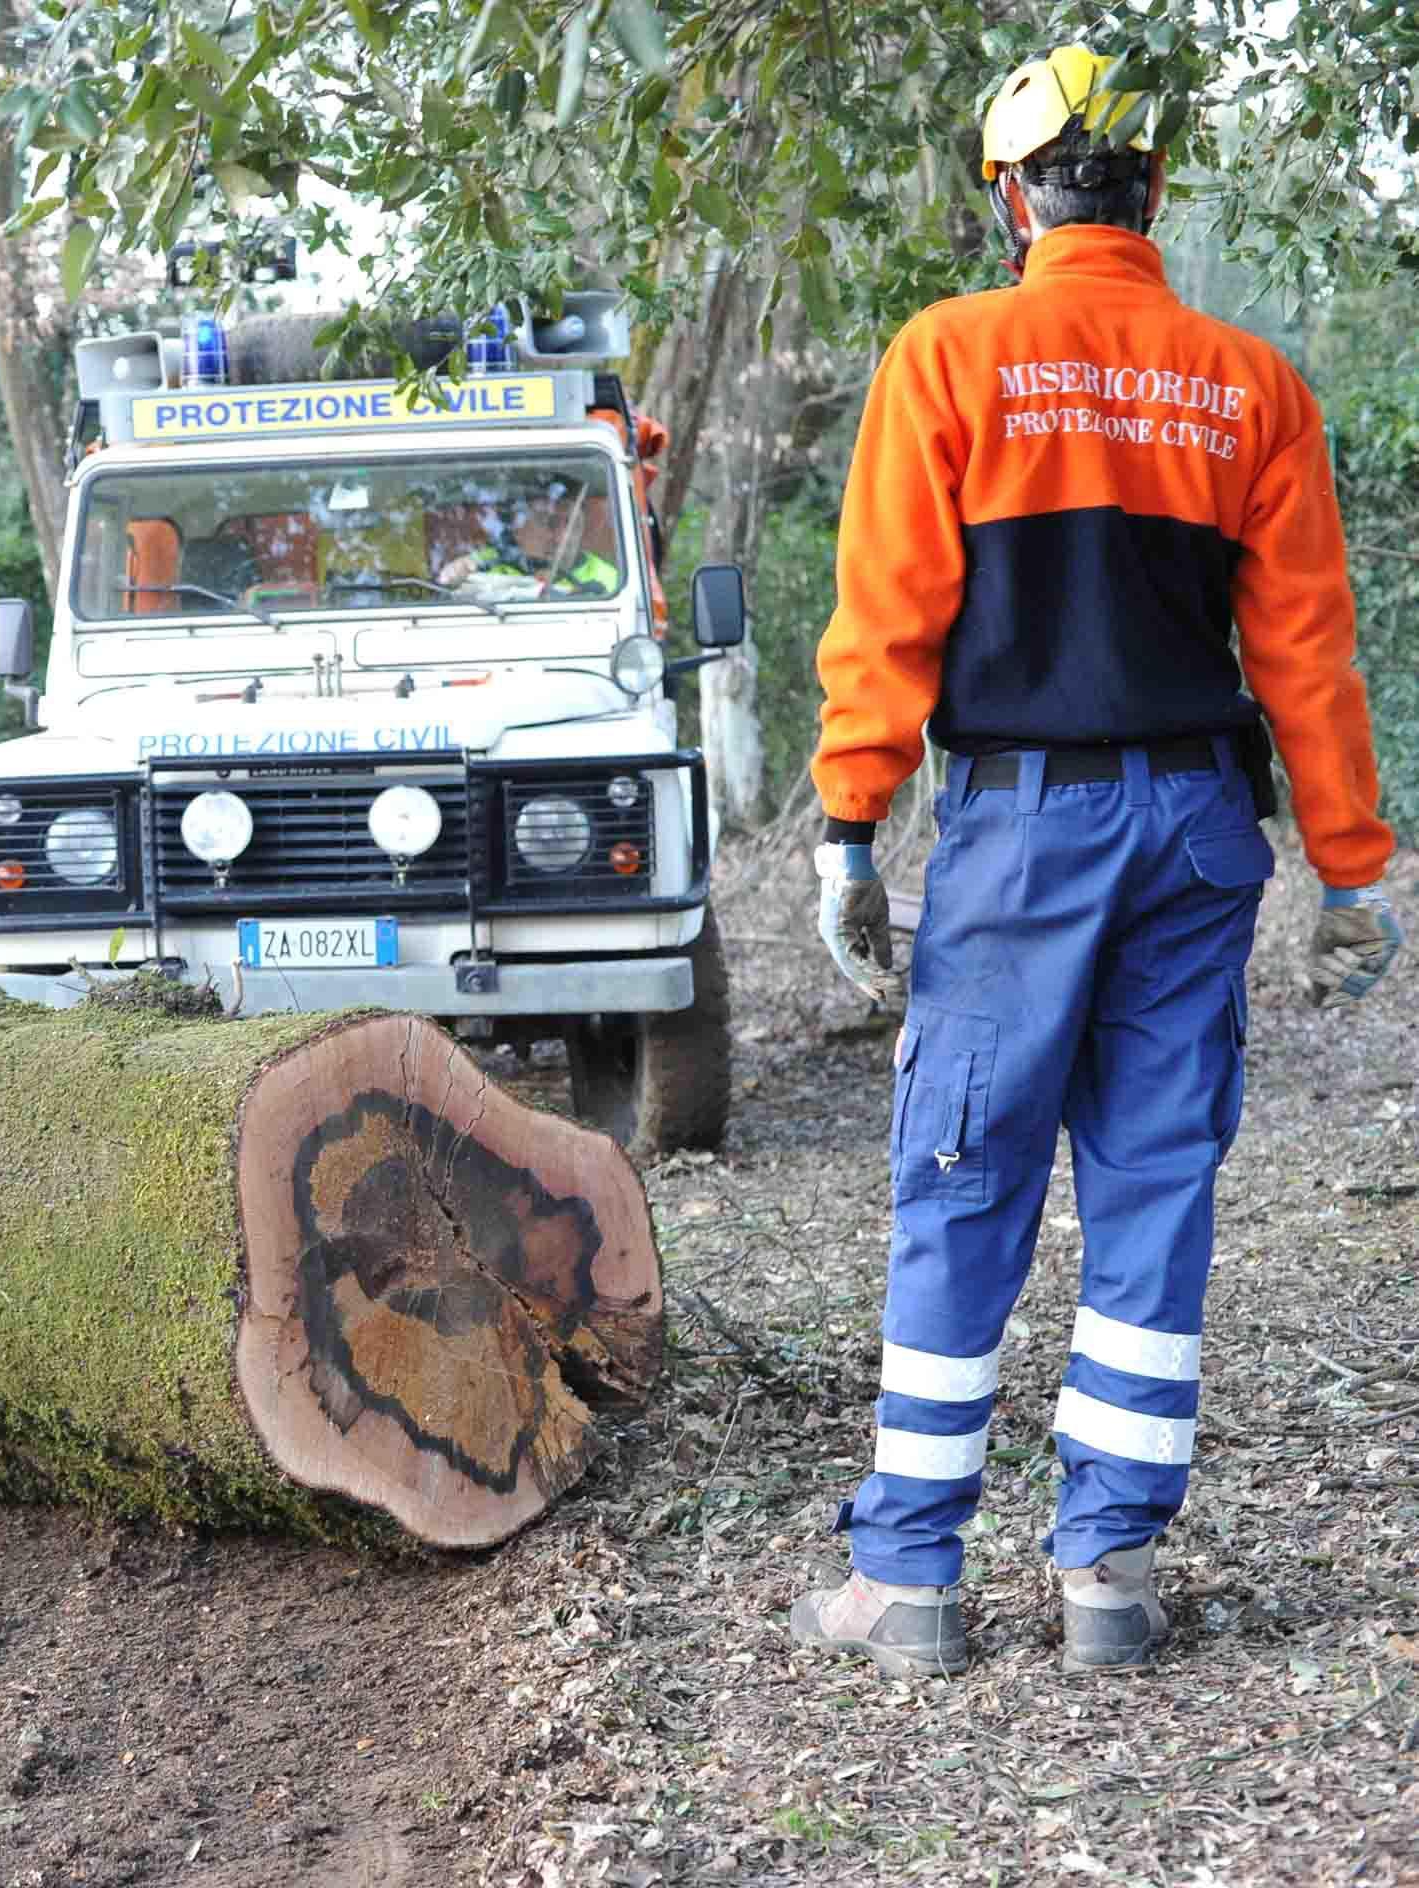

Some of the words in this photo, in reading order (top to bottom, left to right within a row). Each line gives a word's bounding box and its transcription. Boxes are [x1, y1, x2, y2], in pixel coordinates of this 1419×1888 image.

[155, 393, 392, 429] PROTEZIONE
[407, 386, 525, 415] CVILE
[997, 361, 1246, 421] MISERICORDIE
[1003, 407, 1155, 444] PROTEZONE
[138, 730, 359, 759] PROTEZIONE
